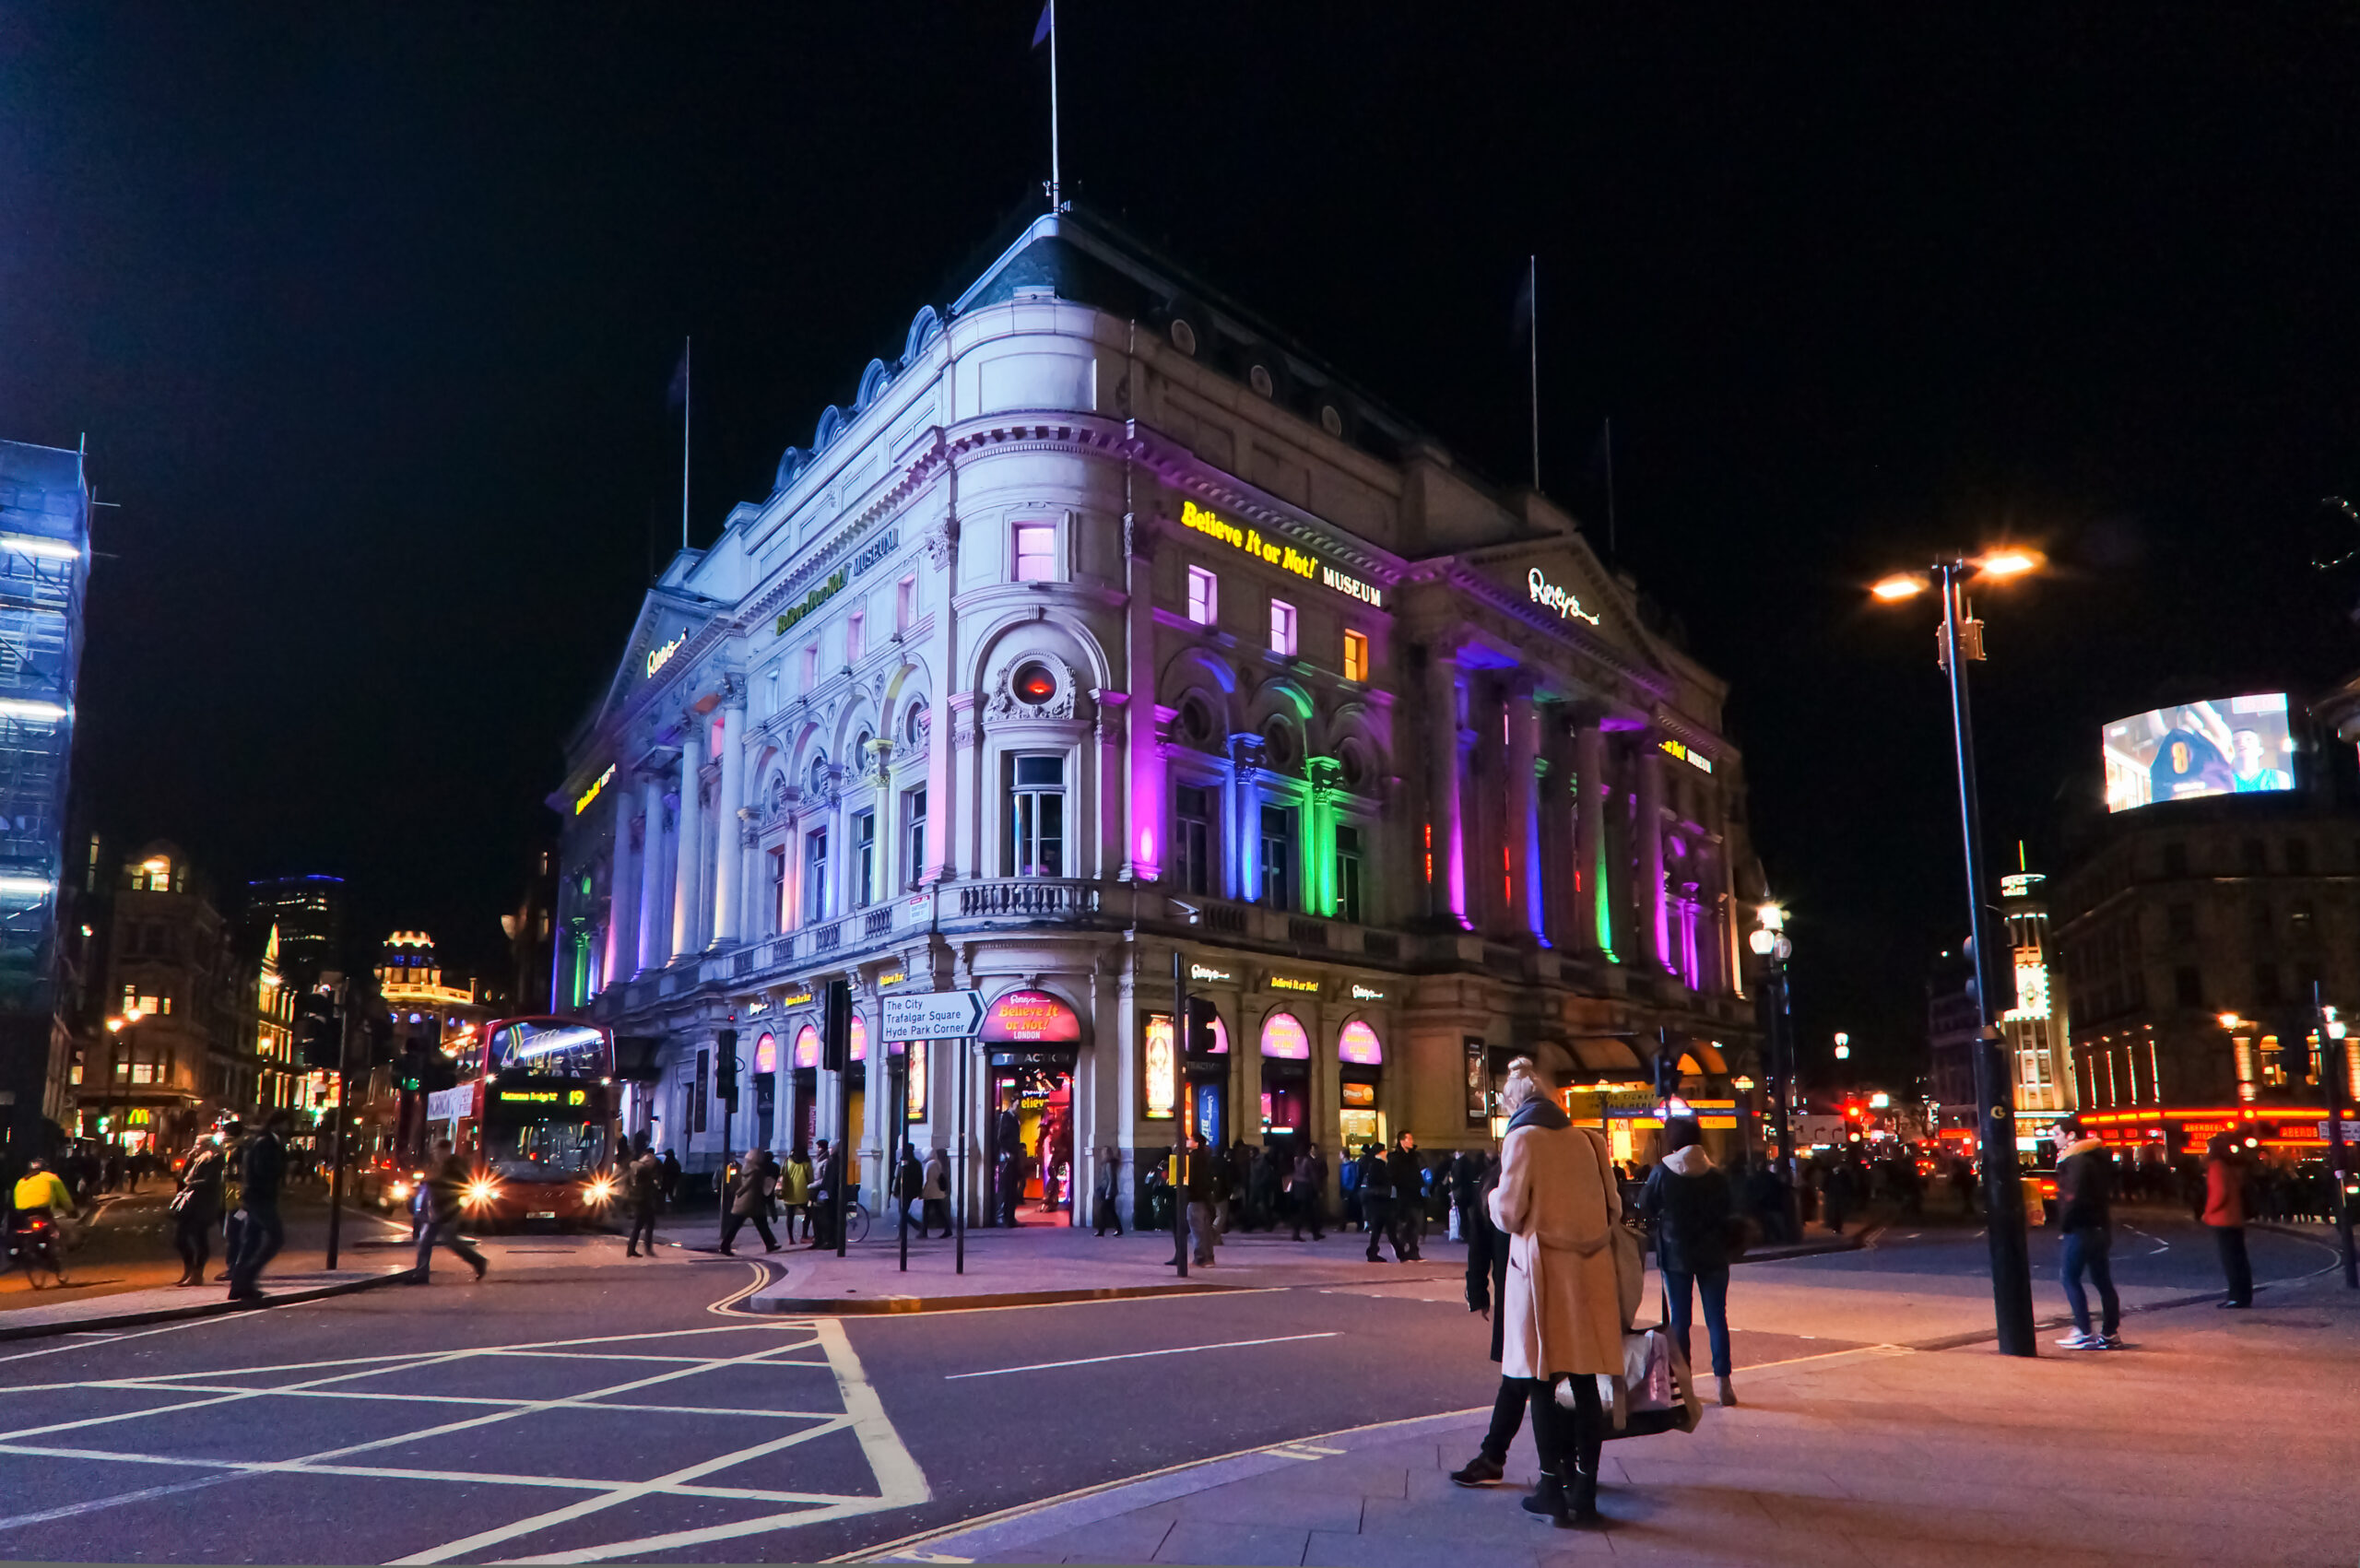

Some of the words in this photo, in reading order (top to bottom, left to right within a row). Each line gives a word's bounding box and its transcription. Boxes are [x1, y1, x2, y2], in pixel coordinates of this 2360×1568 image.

[853, 528, 901, 577] MUSEUM
[1181, 501, 1243, 548] Believe
[1245, 529, 1262, 556] It
[1262, 543, 1281, 564] or
[1281, 547, 1316, 579] Not!
[1323, 566, 1381, 607] MUSEUM
[887, 1000, 903, 1011] The
[904, 999, 923, 1010] City
[998, 1005, 1043, 1018] Believe
[1045, 1005, 1058, 1018] It
[886, 1012, 926, 1024] Trafalgar
[929, 1010, 962, 1023] Square
[885, 1027, 908, 1039] Hyde
[911, 1025, 930, 1035] Park
[933, 1023, 964, 1034] Corner
[1006, 1020, 1017, 1031] or
[1021, 1019, 1049, 1031] Not!
[1013, 1031, 1041, 1040] LONDON
[569, 1090, 585, 1106] 19
